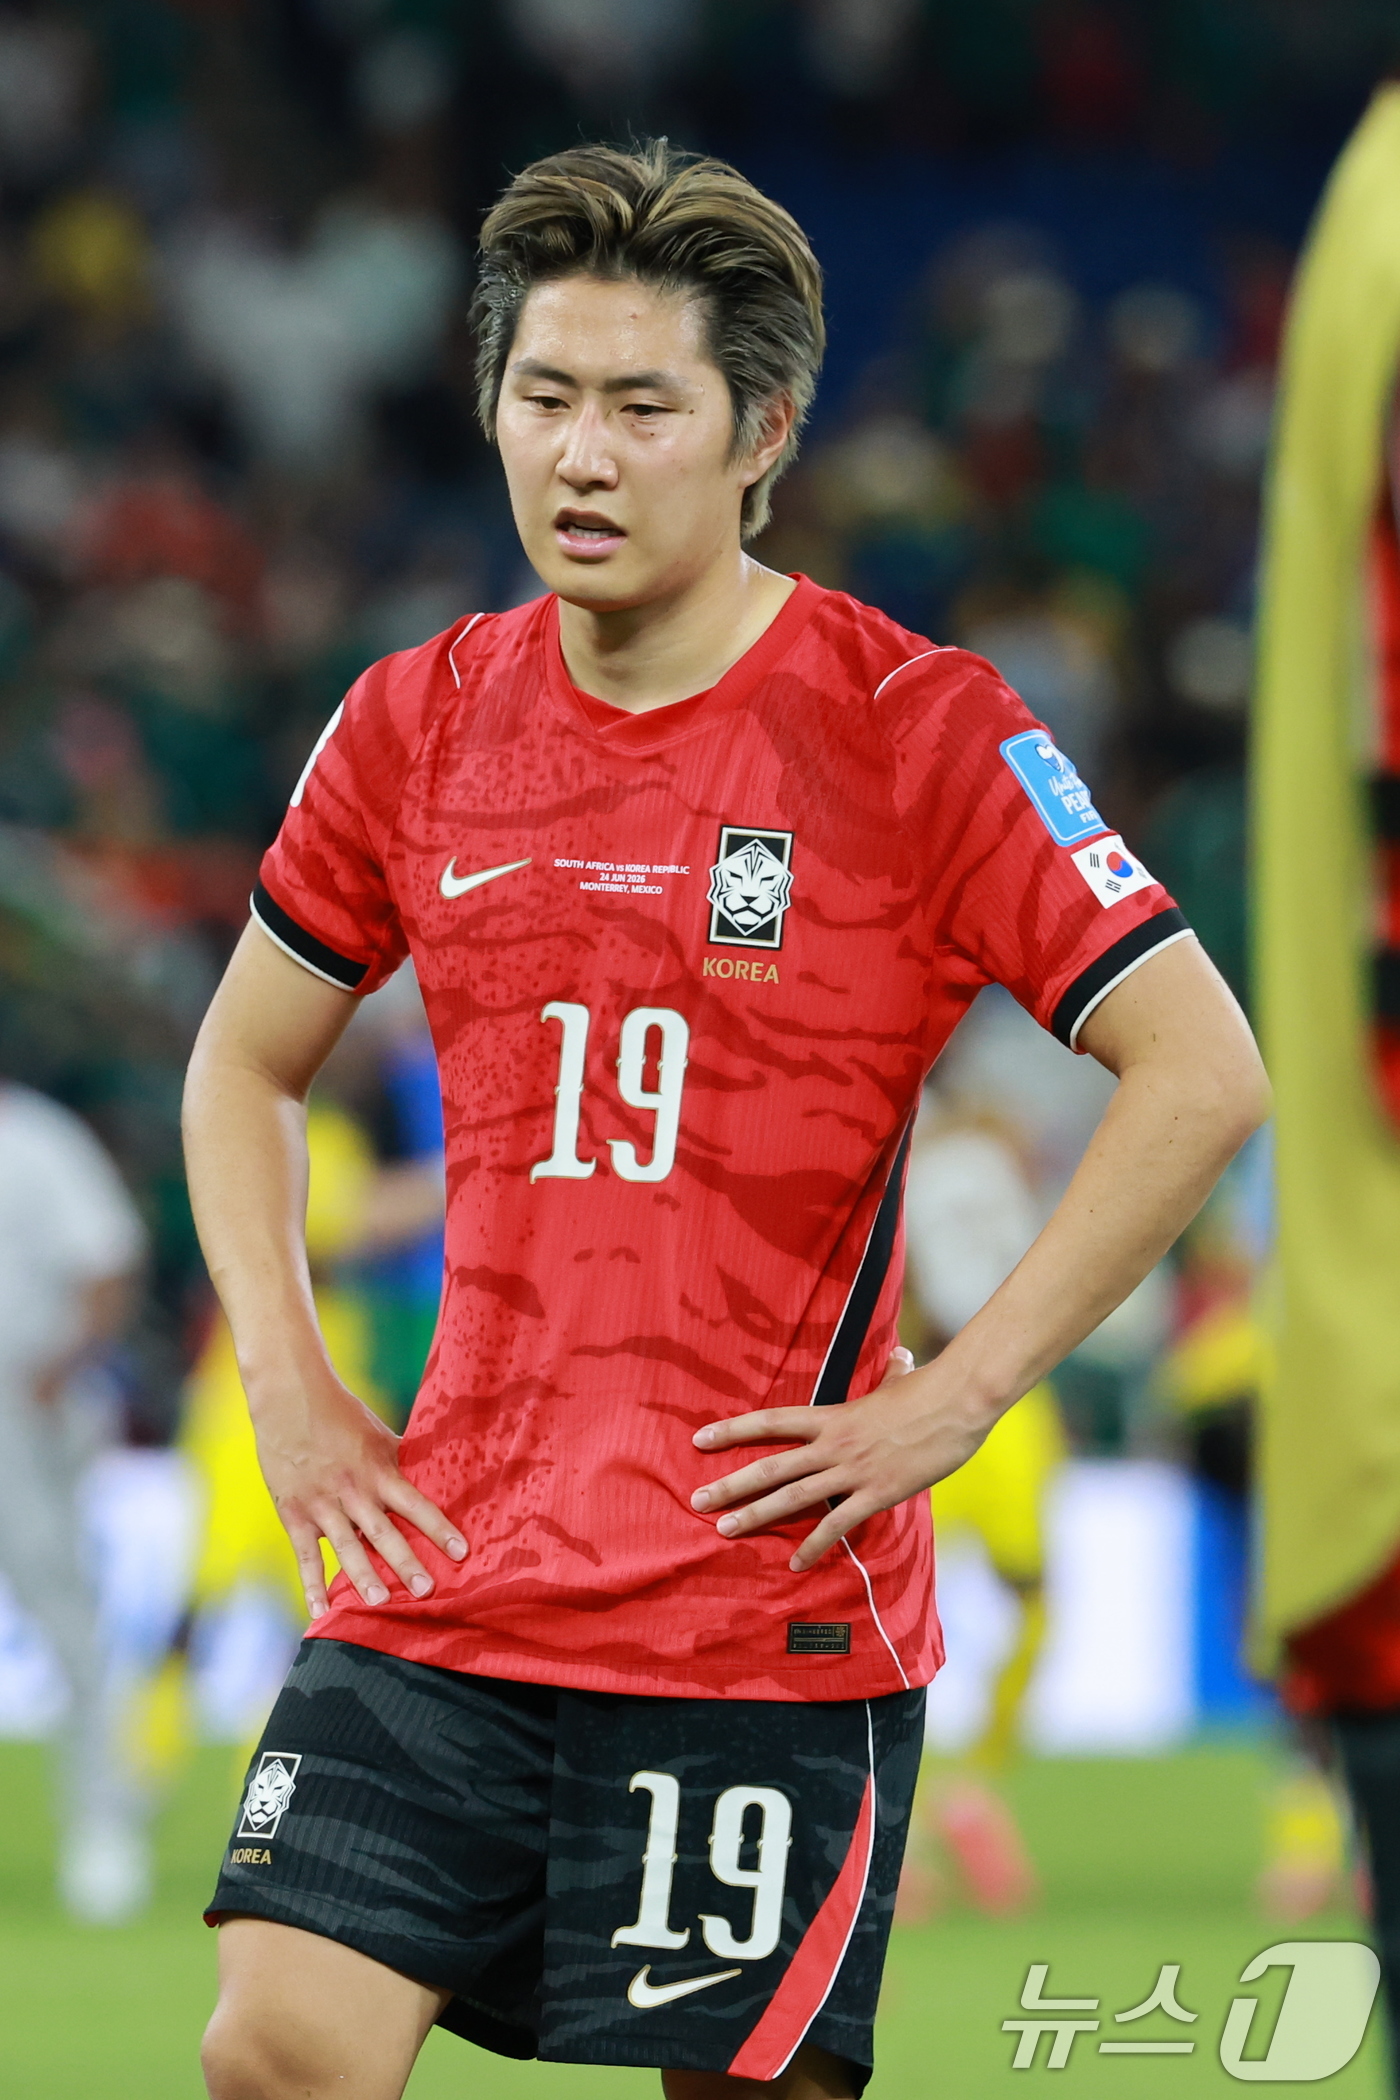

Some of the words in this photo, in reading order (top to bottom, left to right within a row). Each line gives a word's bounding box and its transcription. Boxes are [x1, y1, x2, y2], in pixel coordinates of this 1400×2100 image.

[1061, 790, 1090, 815] PEA
[554, 859, 584, 869] SOUTH
[585, 861, 615, 872] AFRICA
[625, 864, 651, 873] KOREA
[599, 872, 609, 881] 24
[611, 873, 625, 882] JUN
[627, 874, 646, 883] 2026
[580, 882, 630, 894] MONTERREY,
[631, 885, 663, 895] MEXICO
[702, 957, 780, 985] KOREA
[529, 1000, 691, 1185] 19
[230, 1847, 272, 1865] KOREA
[610, 1769, 793, 1961] 19
